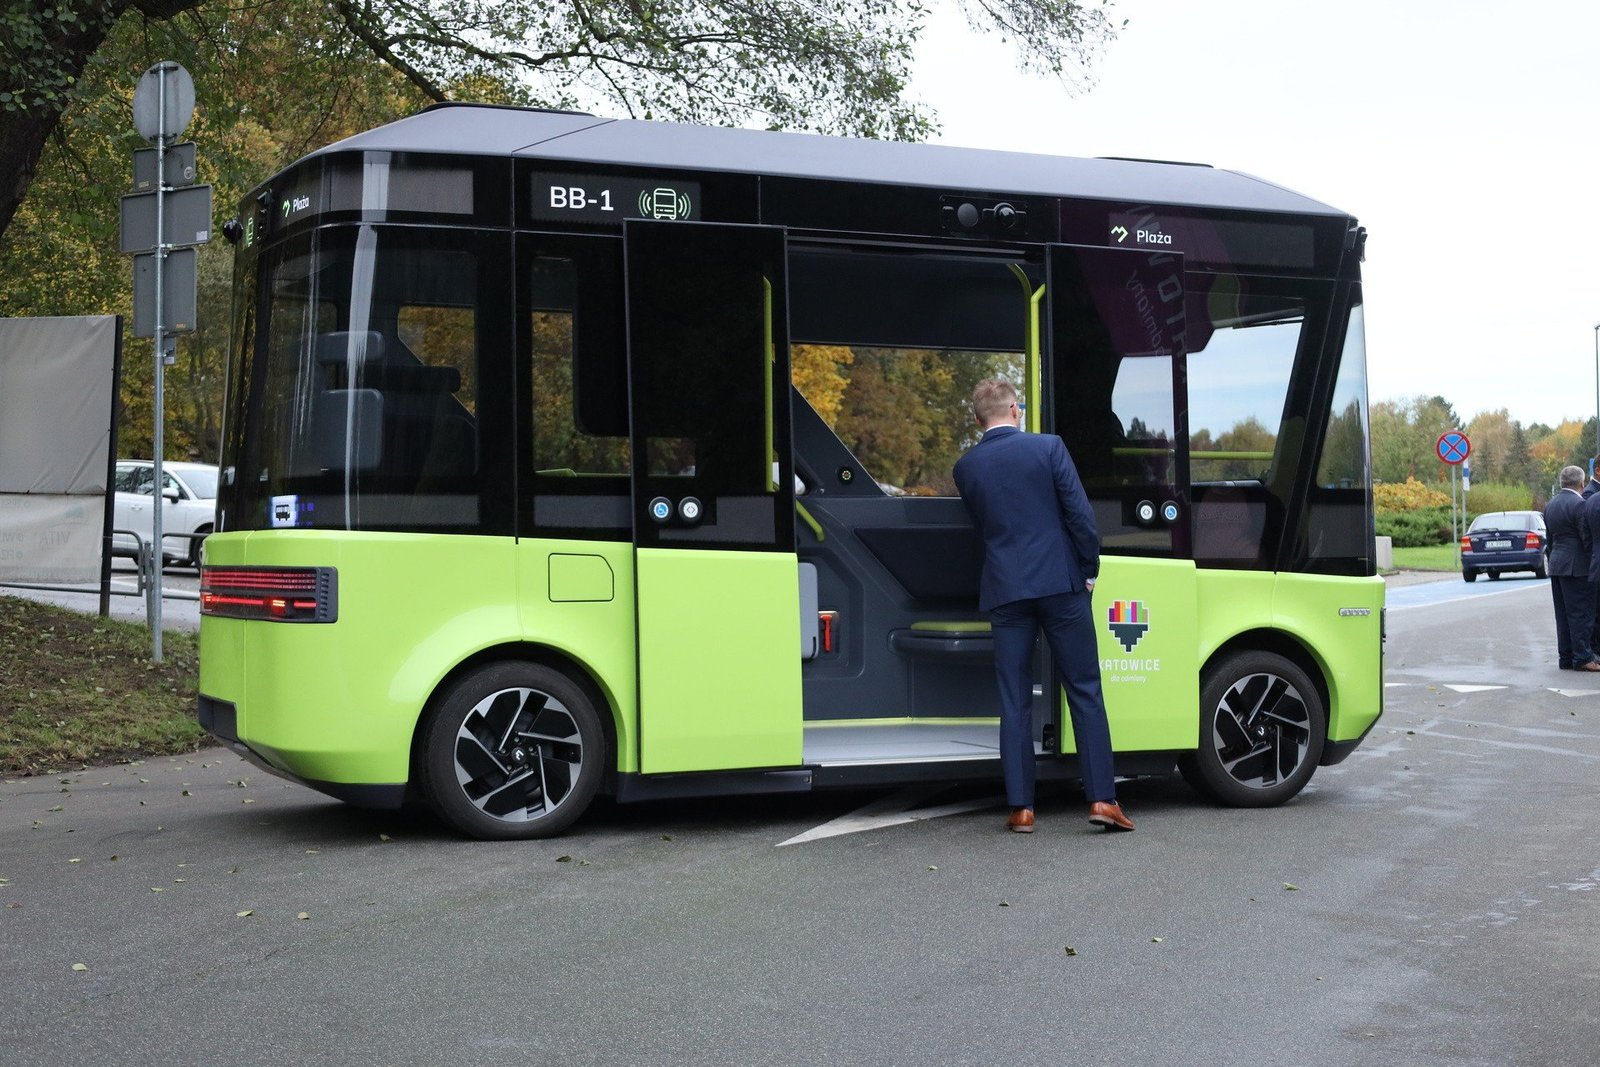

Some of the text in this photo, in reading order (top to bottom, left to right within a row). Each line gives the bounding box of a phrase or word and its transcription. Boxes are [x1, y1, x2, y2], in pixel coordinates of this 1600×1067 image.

[293, 195, 310, 213] Plaża
[550, 186, 614, 211] BB-1
[1136, 230, 1172, 245] Plaża
